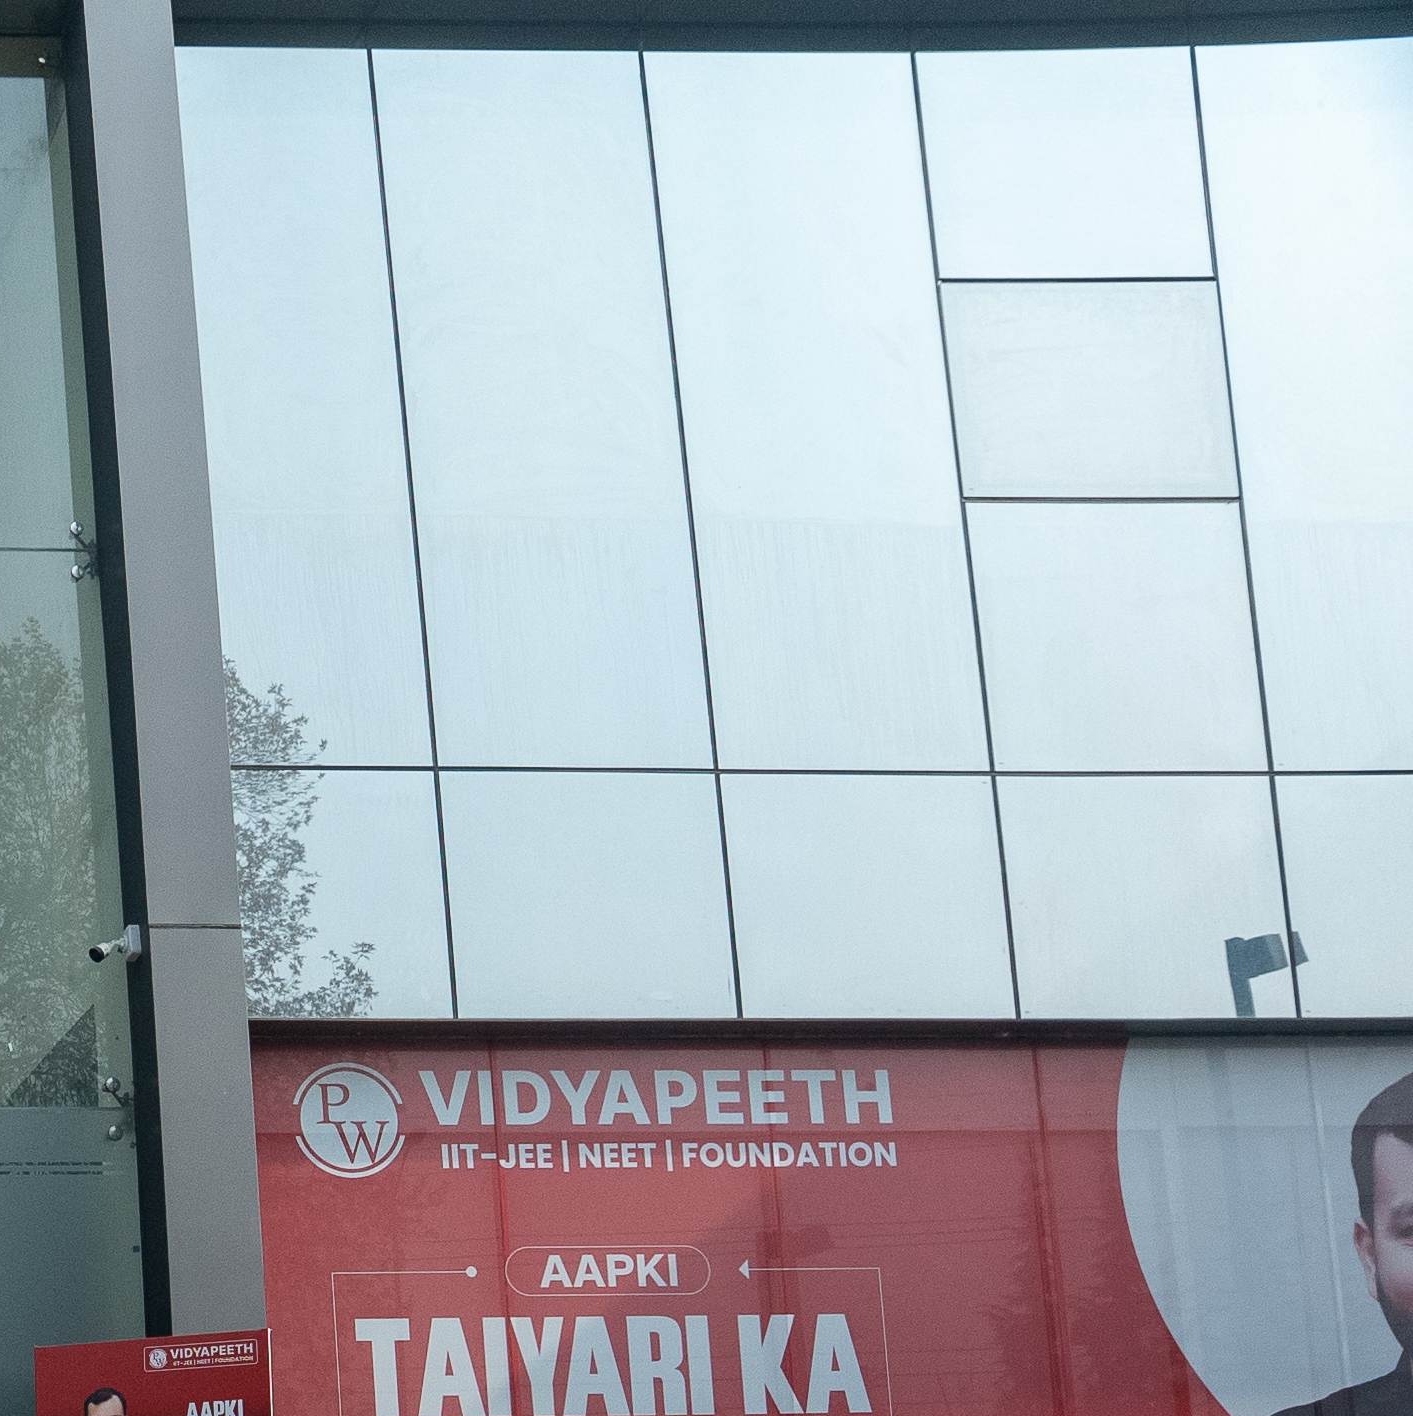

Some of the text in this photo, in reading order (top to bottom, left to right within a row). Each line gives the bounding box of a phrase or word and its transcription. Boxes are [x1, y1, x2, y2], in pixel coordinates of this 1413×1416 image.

[418, 1068, 894, 1126] VIDYAPEETH
[440, 1142, 898, 1170] IIT-JEE NEET FOUNDATION
[539, 1253, 680, 1289] AAPKI
[170, 1343, 254, 1359] VIDYAPEETH
[737, 1313, 873, 1415] KA
